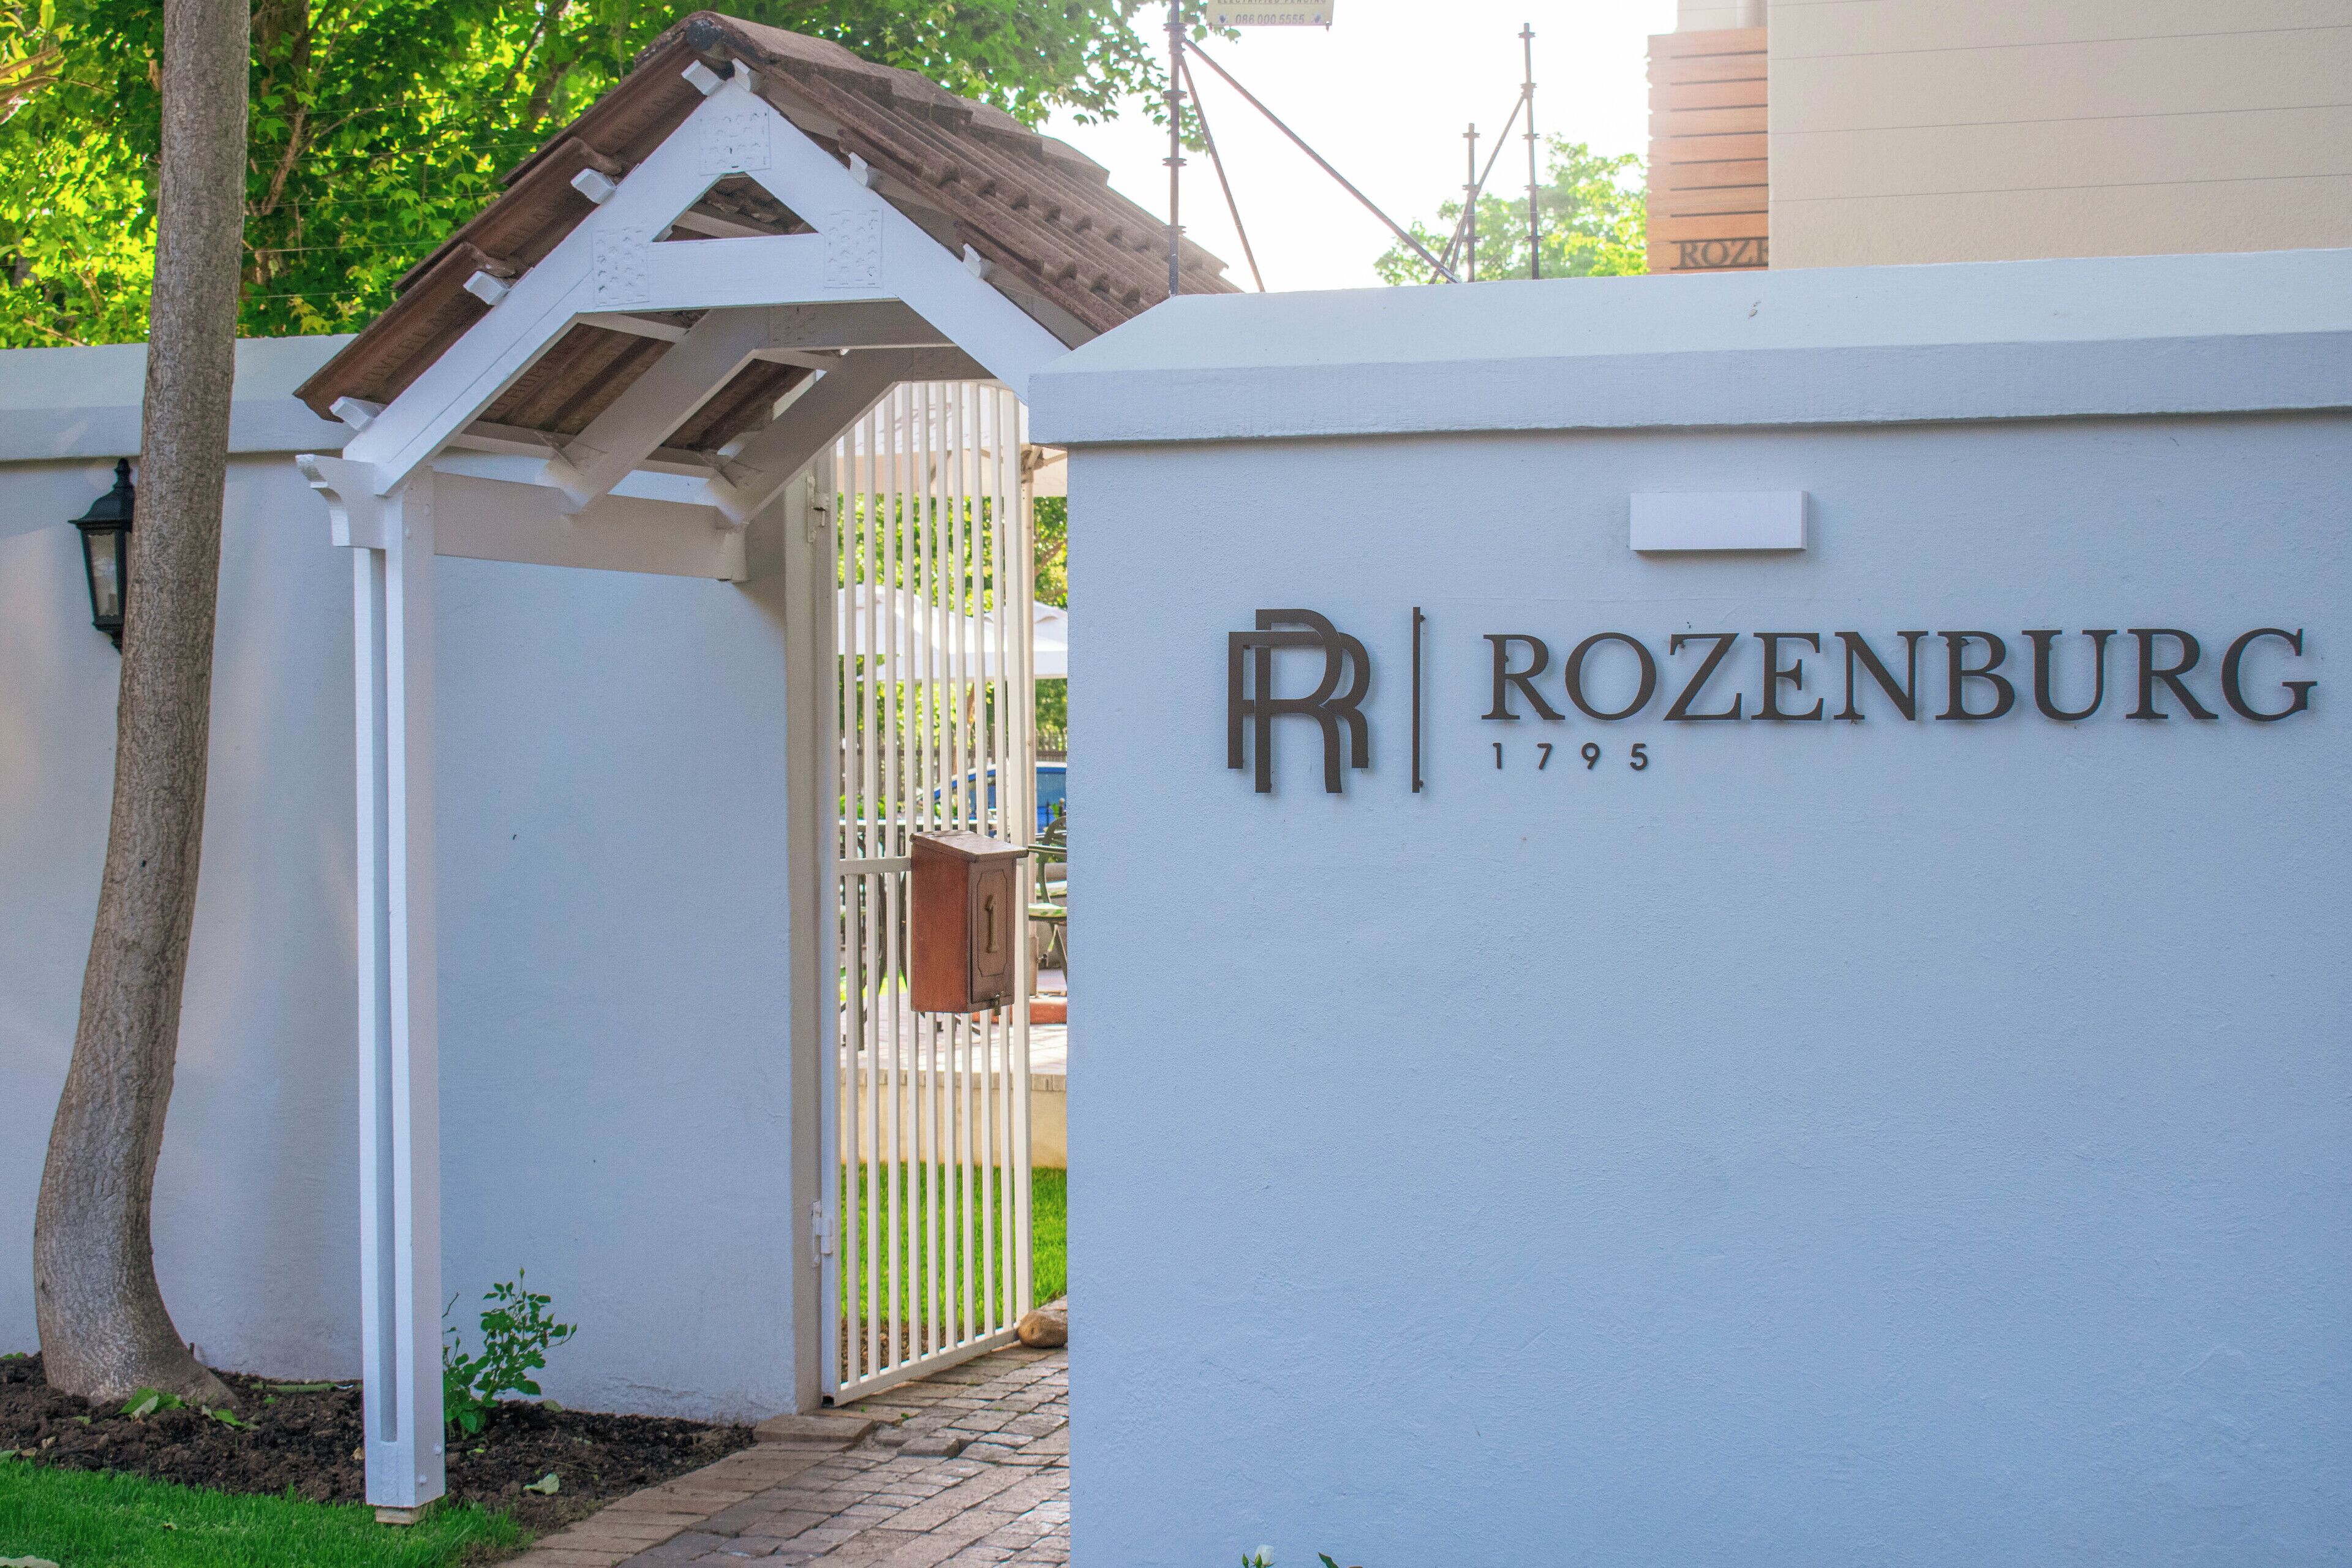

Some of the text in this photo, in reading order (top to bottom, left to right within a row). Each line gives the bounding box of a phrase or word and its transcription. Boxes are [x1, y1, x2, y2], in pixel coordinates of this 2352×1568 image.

[1235, 13, 1305, 24] 086 000 5555
[1481, 628, 2318, 726] ROZENBURG
[1492, 742, 1649, 771] 1795
